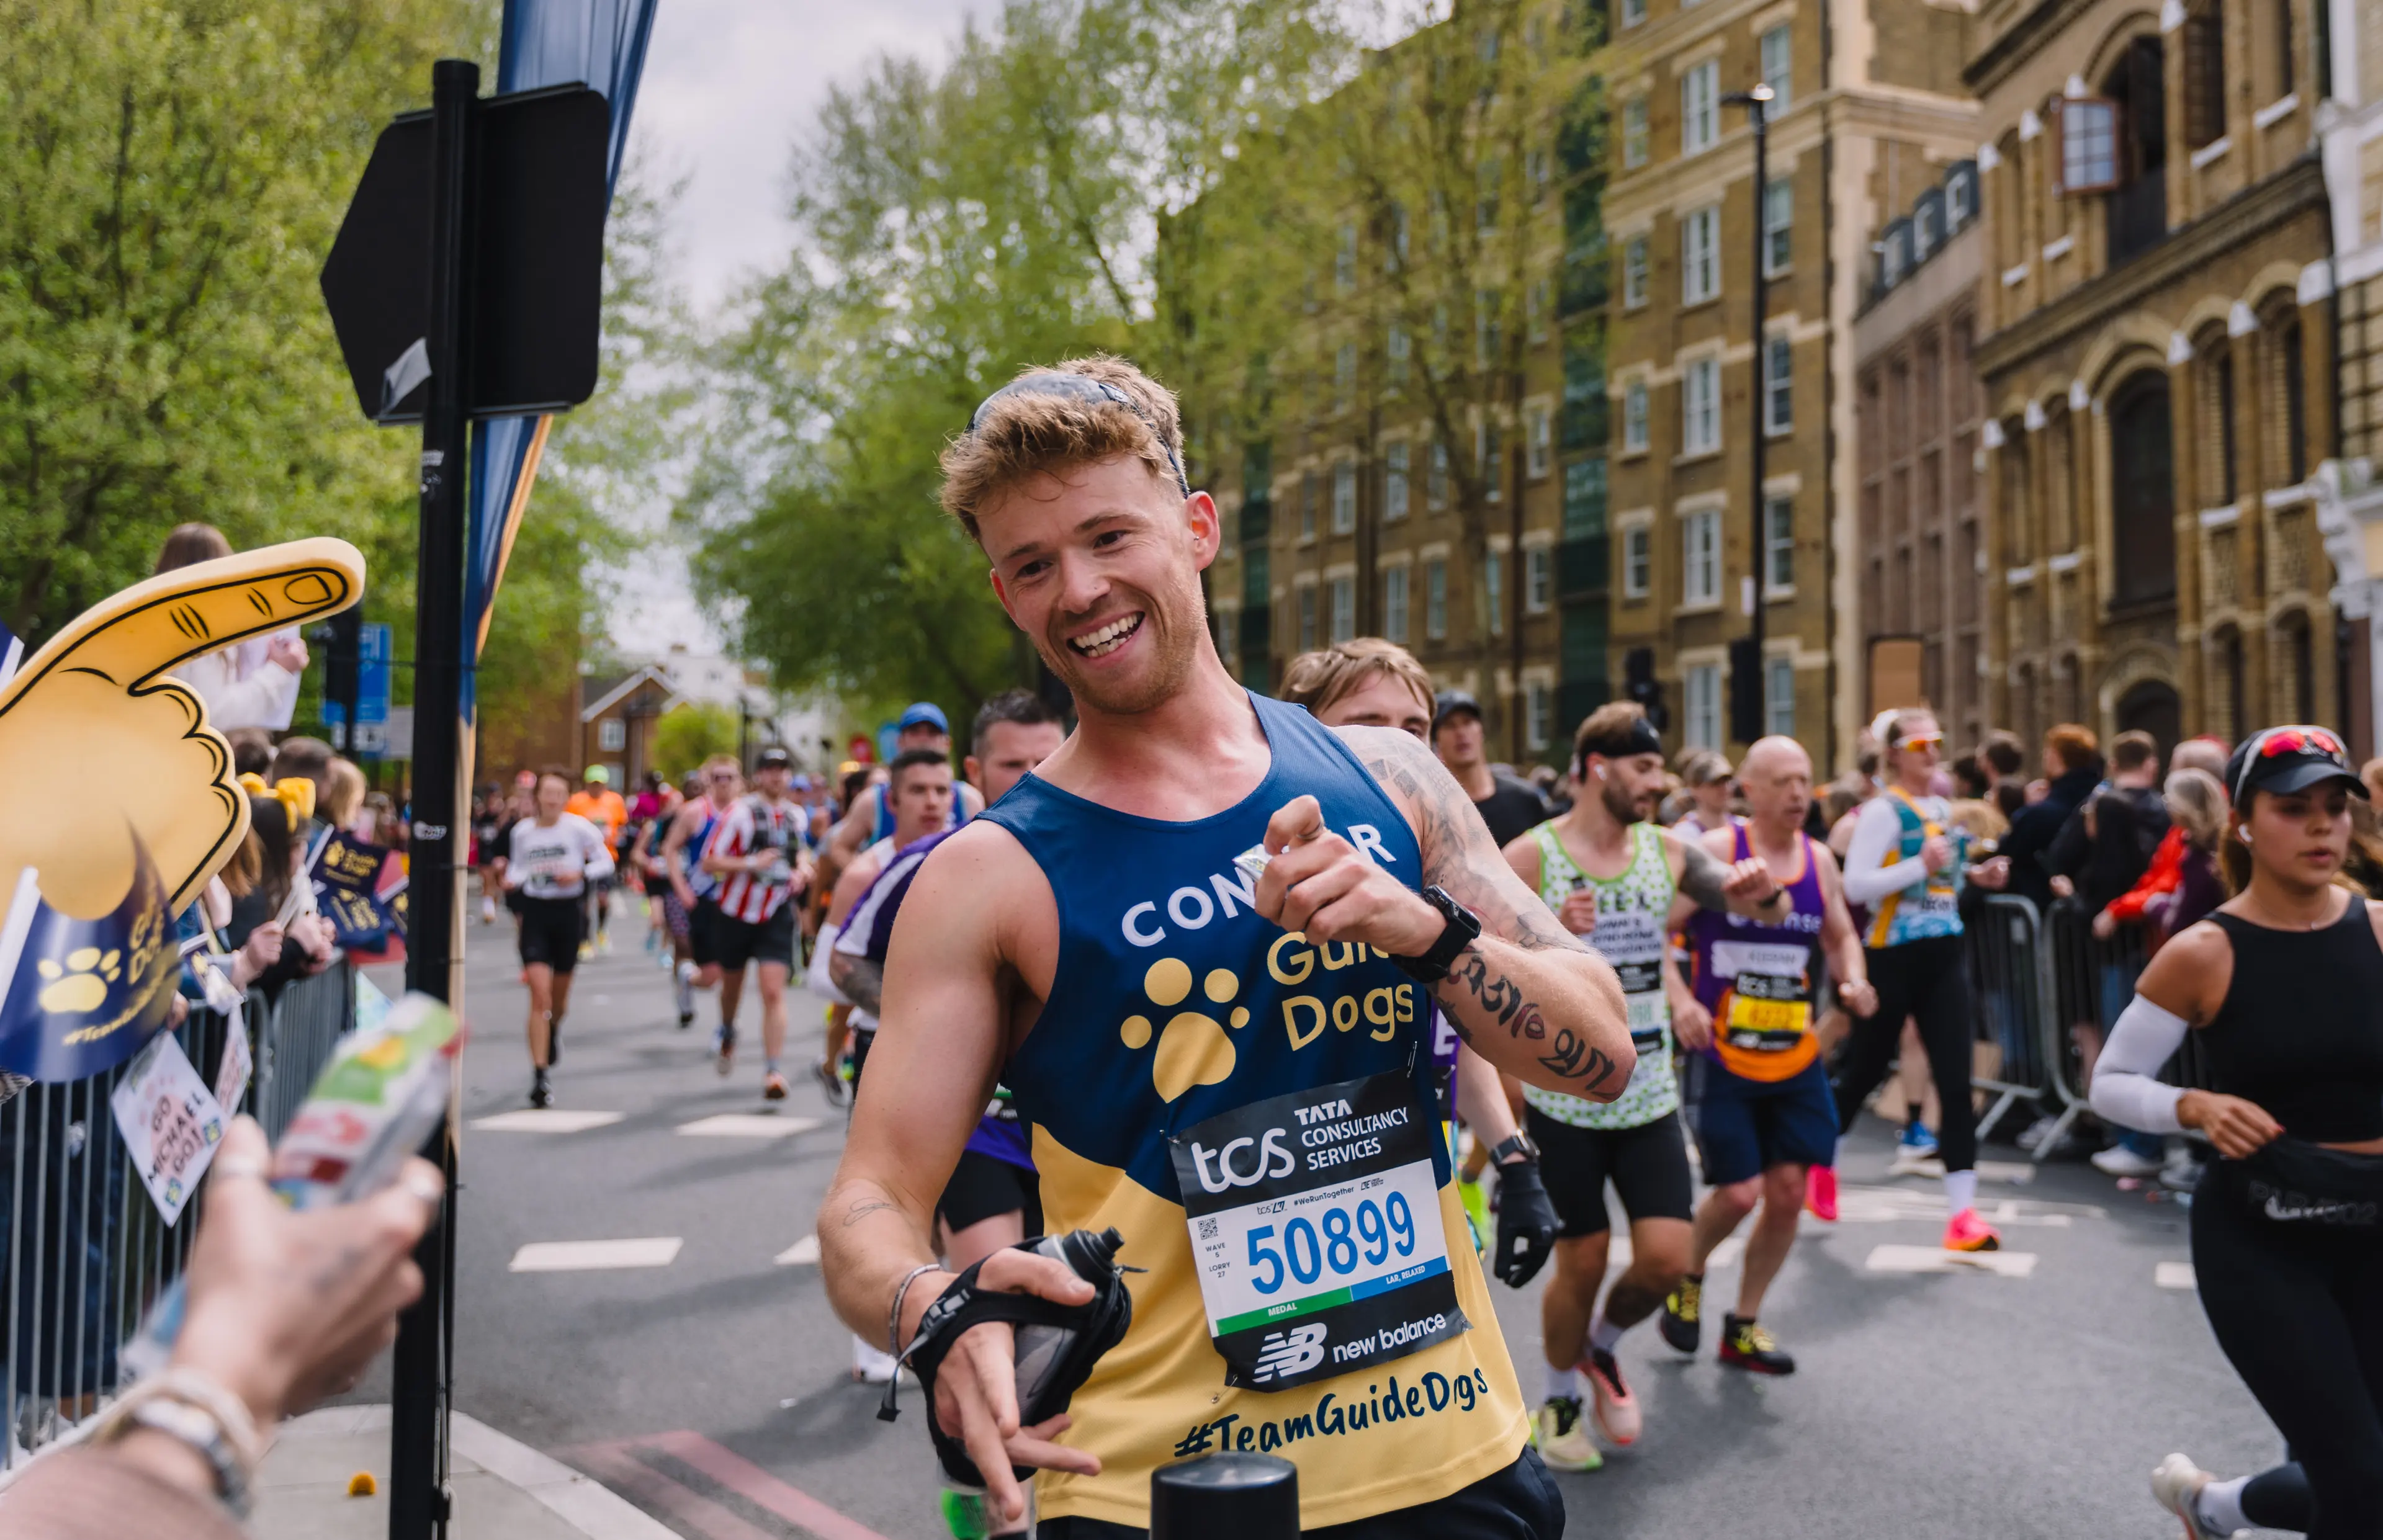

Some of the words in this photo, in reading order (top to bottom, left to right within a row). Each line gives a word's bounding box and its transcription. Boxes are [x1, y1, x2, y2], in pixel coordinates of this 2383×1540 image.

[1282, 984, 1412, 1051] Dogs
[1294, 1099, 1353, 1126] TATA
[1301, 1107, 1409, 1147] CONSULTANCY
[1191, 1127, 1296, 1193] tcs
[1306, 1137, 1382, 1171] SERVICES
[1294, 1186, 1355, 1206] #WeRunTogether
[1205, 1242, 1226, 1252] WAVE
[1247, 1191, 1415, 1294] 50899
[1208, 1261, 1231, 1272] LORRY
[1386, 1274, 1401, 1284] LAR,
[1401, 1265, 1425, 1280] RELAXED
[1268, 1302, 1298, 1317] MEDAL
[1333, 1335, 1376, 1364] new
[1379, 1312, 1447, 1350] balance
[1174, 1367, 1489, 1457] #TeamGuideDgs
